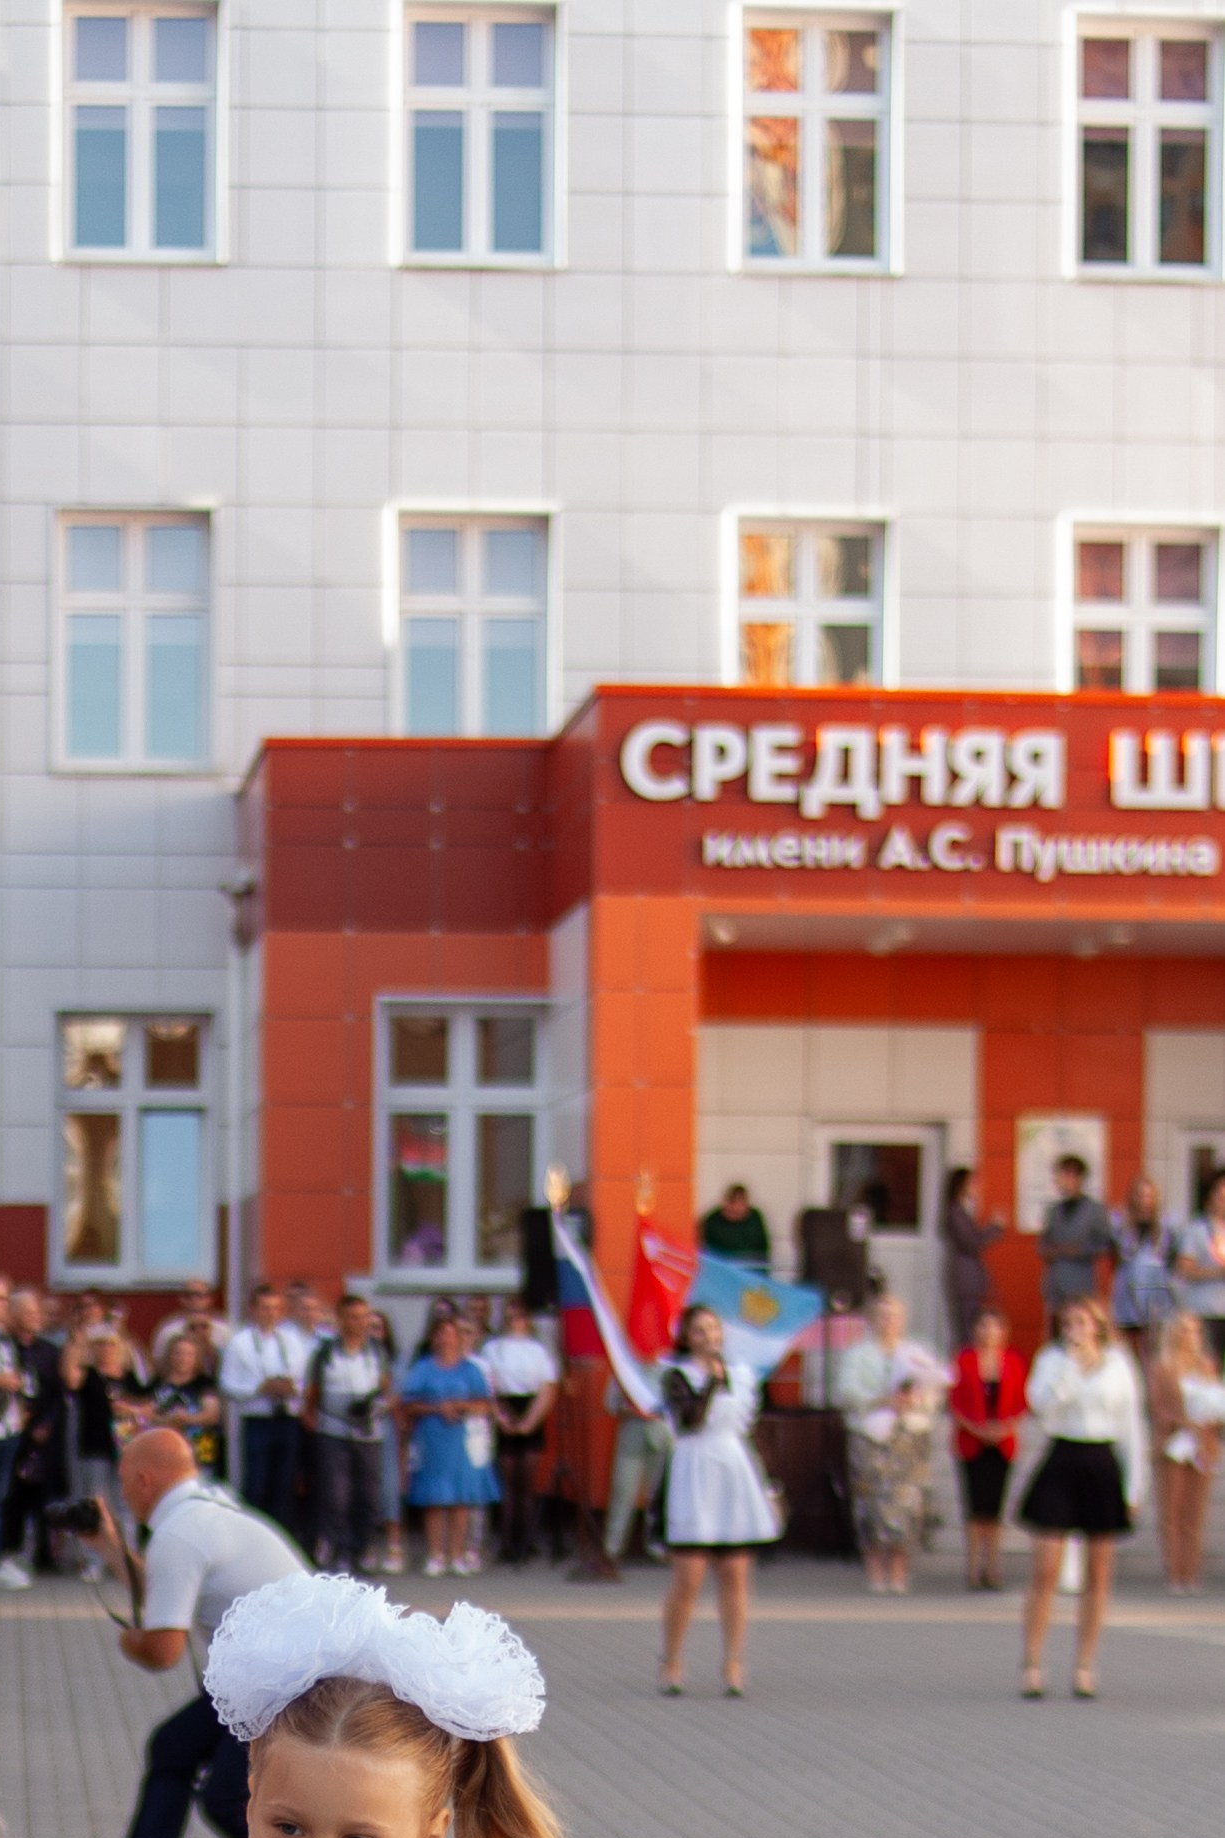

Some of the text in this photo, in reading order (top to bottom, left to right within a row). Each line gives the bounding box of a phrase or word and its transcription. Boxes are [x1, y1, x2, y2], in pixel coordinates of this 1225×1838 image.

[621, 720, 1066, 819] СРЕДНЯЯ
[702, 824, 1221, 882] имени А.С. Пушкина
